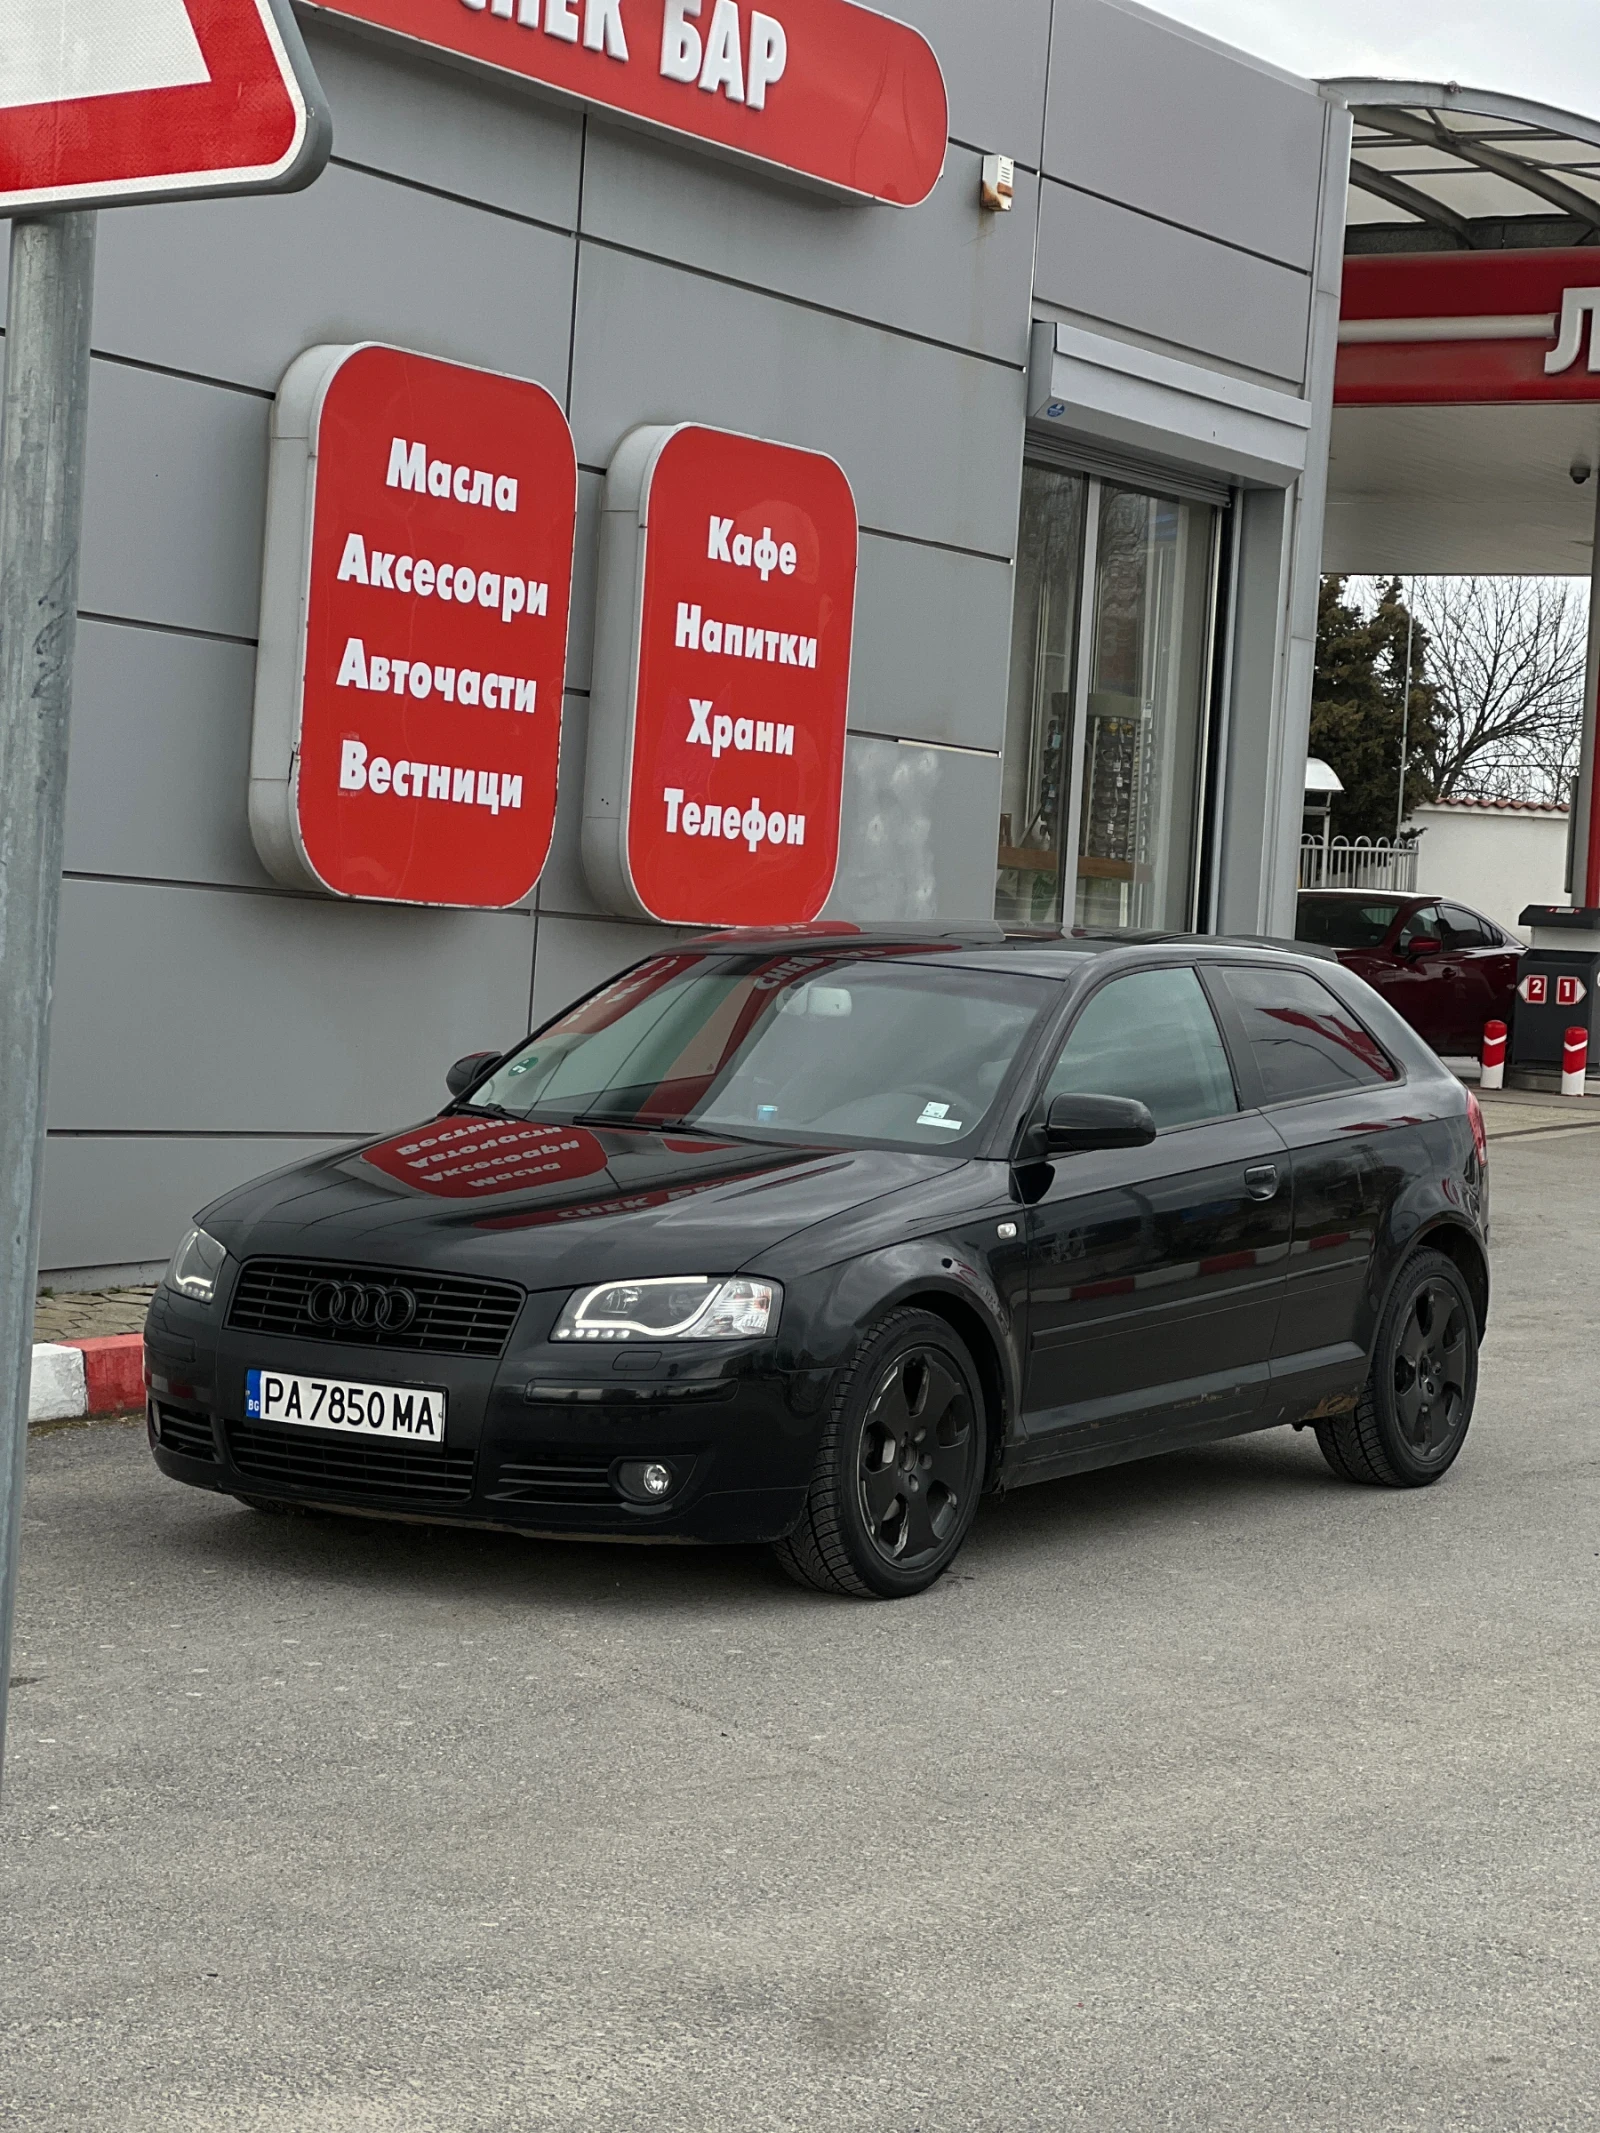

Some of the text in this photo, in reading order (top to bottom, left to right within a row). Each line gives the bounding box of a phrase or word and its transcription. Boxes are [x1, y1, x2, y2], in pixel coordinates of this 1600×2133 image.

[660, 0, 788, 110] БАР
[386, 437, 518, 512] Масла
[337, 532, 548, 623] Аксесоари
[707, 515, 797, 582] Кафе
[675, 601, 818, 668] Напитки
[336, 637, 537, 713] Авточасти
[686, 698, 795, 758] Храни
[339, 739, 523, 815] Вестници
[663, 787, 806, 852] Телефон
[1531, 979, 1543, 994] 2
[1563, 981, 1571, 997] 1
[248, 1399, 260, 1412] BG
[309, 1383, 385, 1429] 7850
[392, 1393, 435, 1435] MA
